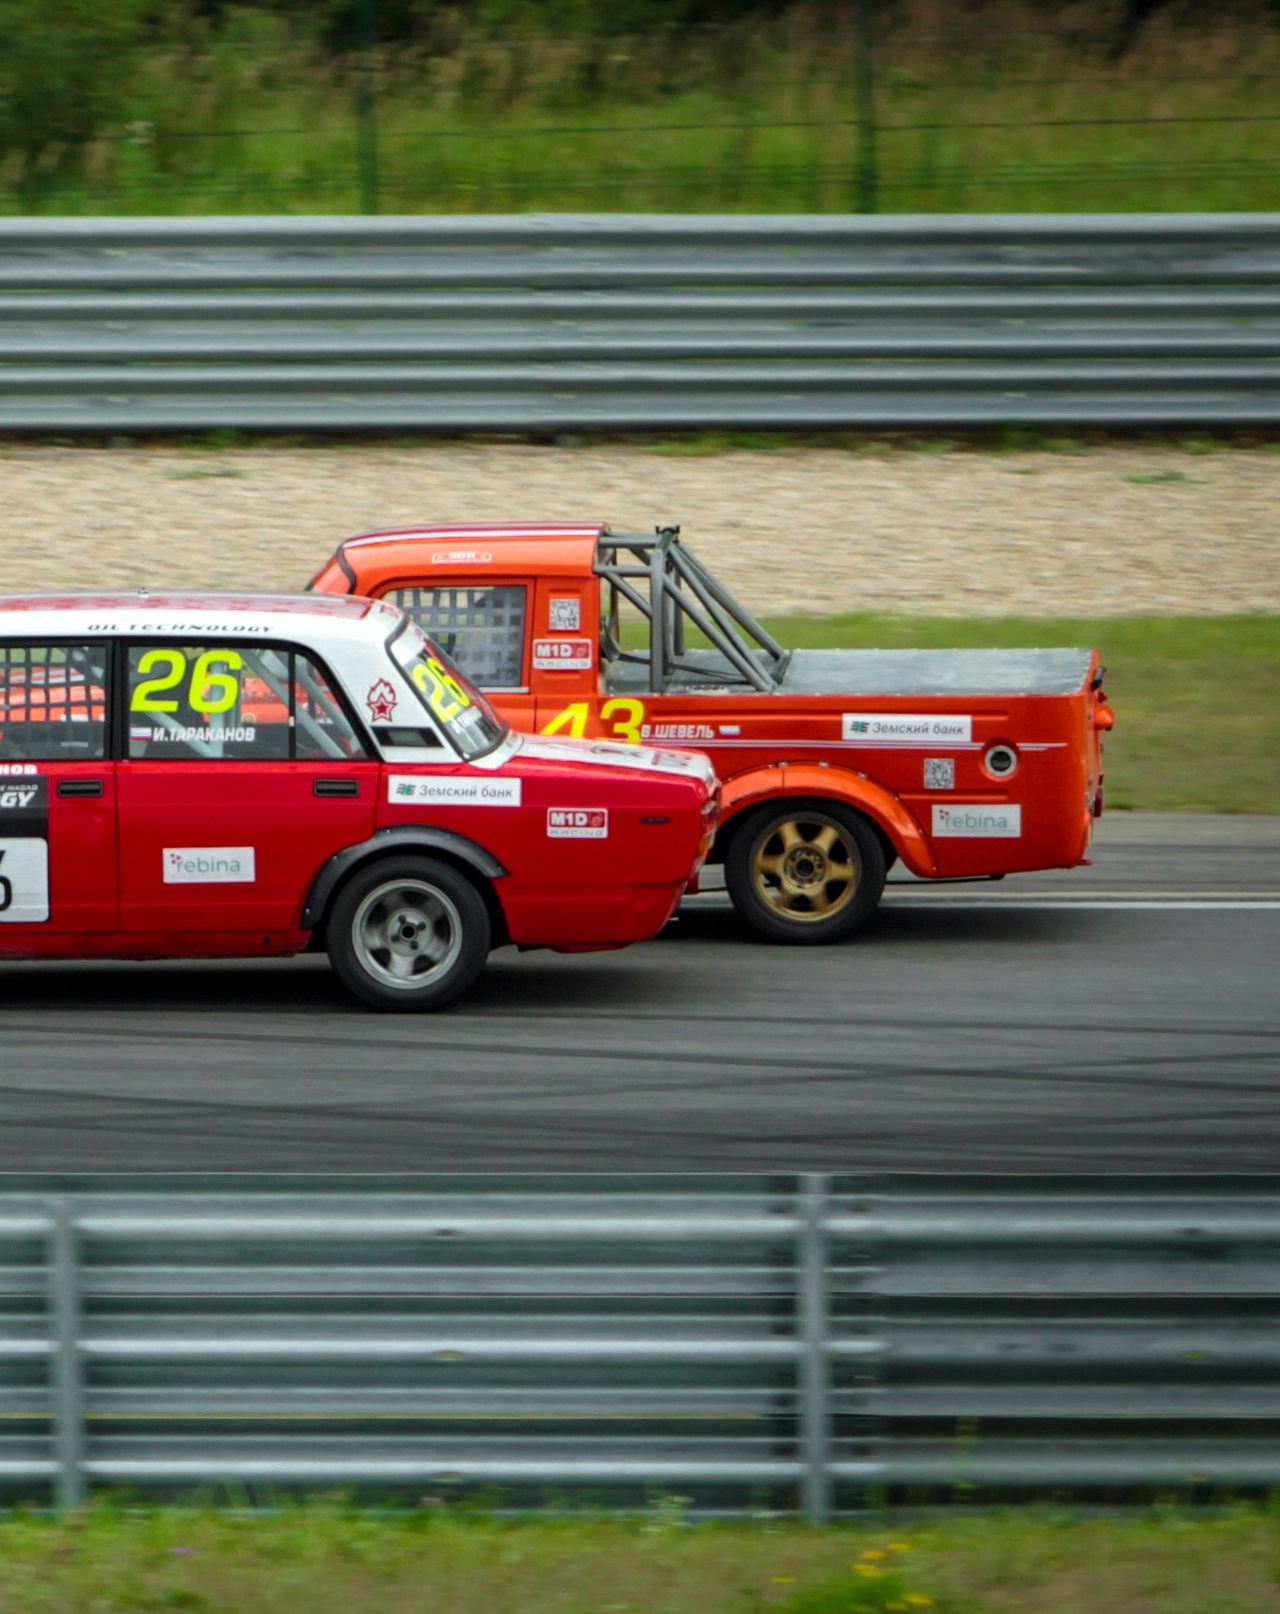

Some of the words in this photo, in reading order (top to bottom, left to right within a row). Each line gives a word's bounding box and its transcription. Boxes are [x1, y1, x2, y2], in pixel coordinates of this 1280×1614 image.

[87, 624, 120, 632] OIL
[128, 623, 274, 633] TECHNOLOGY
[536, 643, 573, 658] M1D
[130, 649, 243, 713] 26
[412, 657, 472, 724] 26
[152, 726, 256, 742] И.ТАРАКАНОВ
[640, 724, 715, 739] В.ШЕВЕЛЬ
[872, 722, 929, 734] Земский
[933, 721, 964, 735] банк
[419, 784, 478, 797] Земский
[481, 785, 513, 799] банк
[550, 812, 588, 826] M1D
[944, 812, 1008, 829] rebina
[176, 855, 241, 873] rebina
